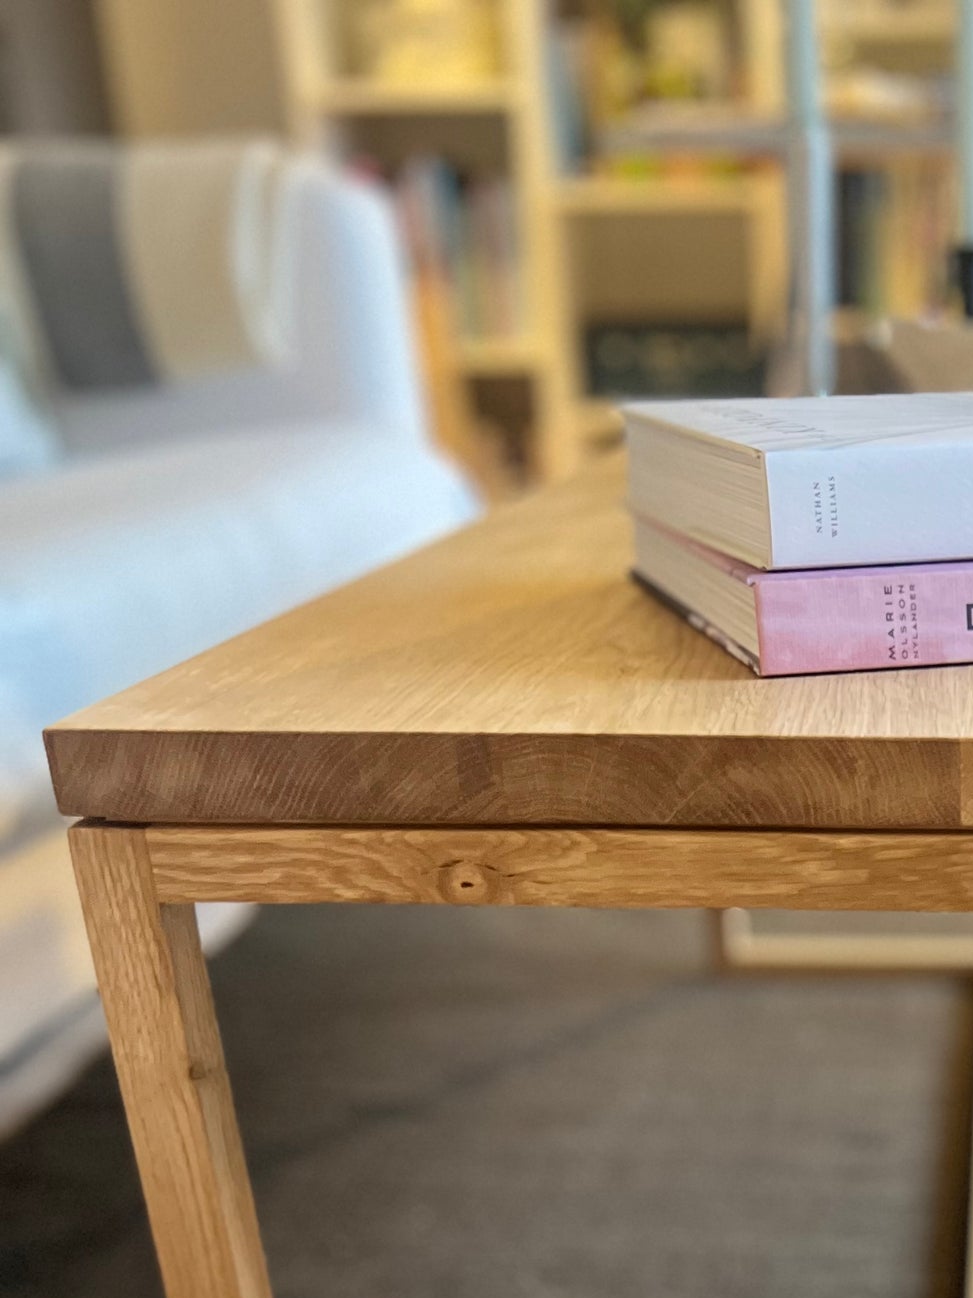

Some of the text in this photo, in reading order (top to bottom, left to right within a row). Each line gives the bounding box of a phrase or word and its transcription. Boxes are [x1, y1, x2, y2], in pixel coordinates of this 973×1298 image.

[813, 481, 823, 534] NATHAN
[828, 476, 838, 538] WILLIAMS
[884, 584, 897, 661] MARIE
[898, 584, 909, 660] OLSSON
[909, 584, 919, 660] NYLANDER
